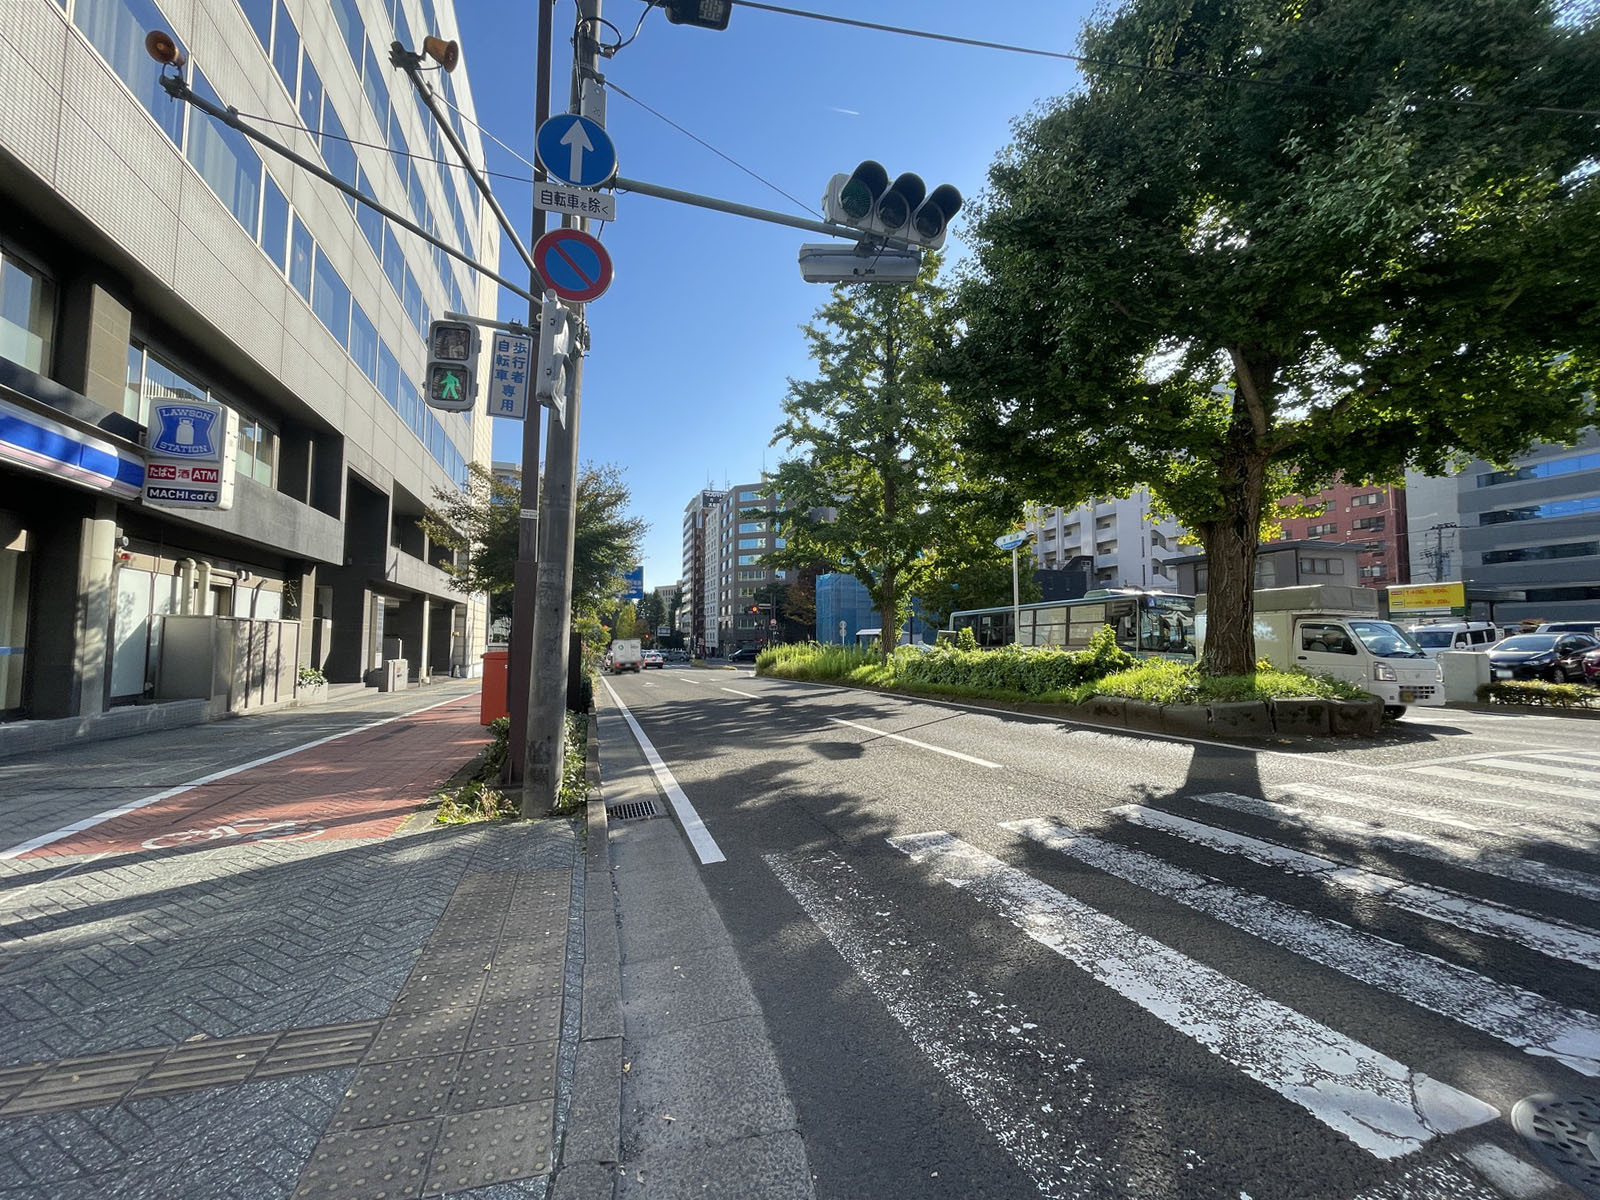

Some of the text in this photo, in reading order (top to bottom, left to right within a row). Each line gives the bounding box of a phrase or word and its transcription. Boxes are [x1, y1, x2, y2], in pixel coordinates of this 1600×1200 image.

[541, 189, 609, 215] 自転車を除く
[495, 339, 510, 382] 自転車
[511, 342, 527, 384] 歩行者
[500, 384, 516, 412] 専用
[162, 409, 212, 421] LAWSON
[159, 442, 207, 453] STATION
[149, 467, 175, 478] たばこ
[177, 468, 190, 479] 酒
[192, 469, 217, 481] ATM
[149, 488, 216, 502] MACHI café
